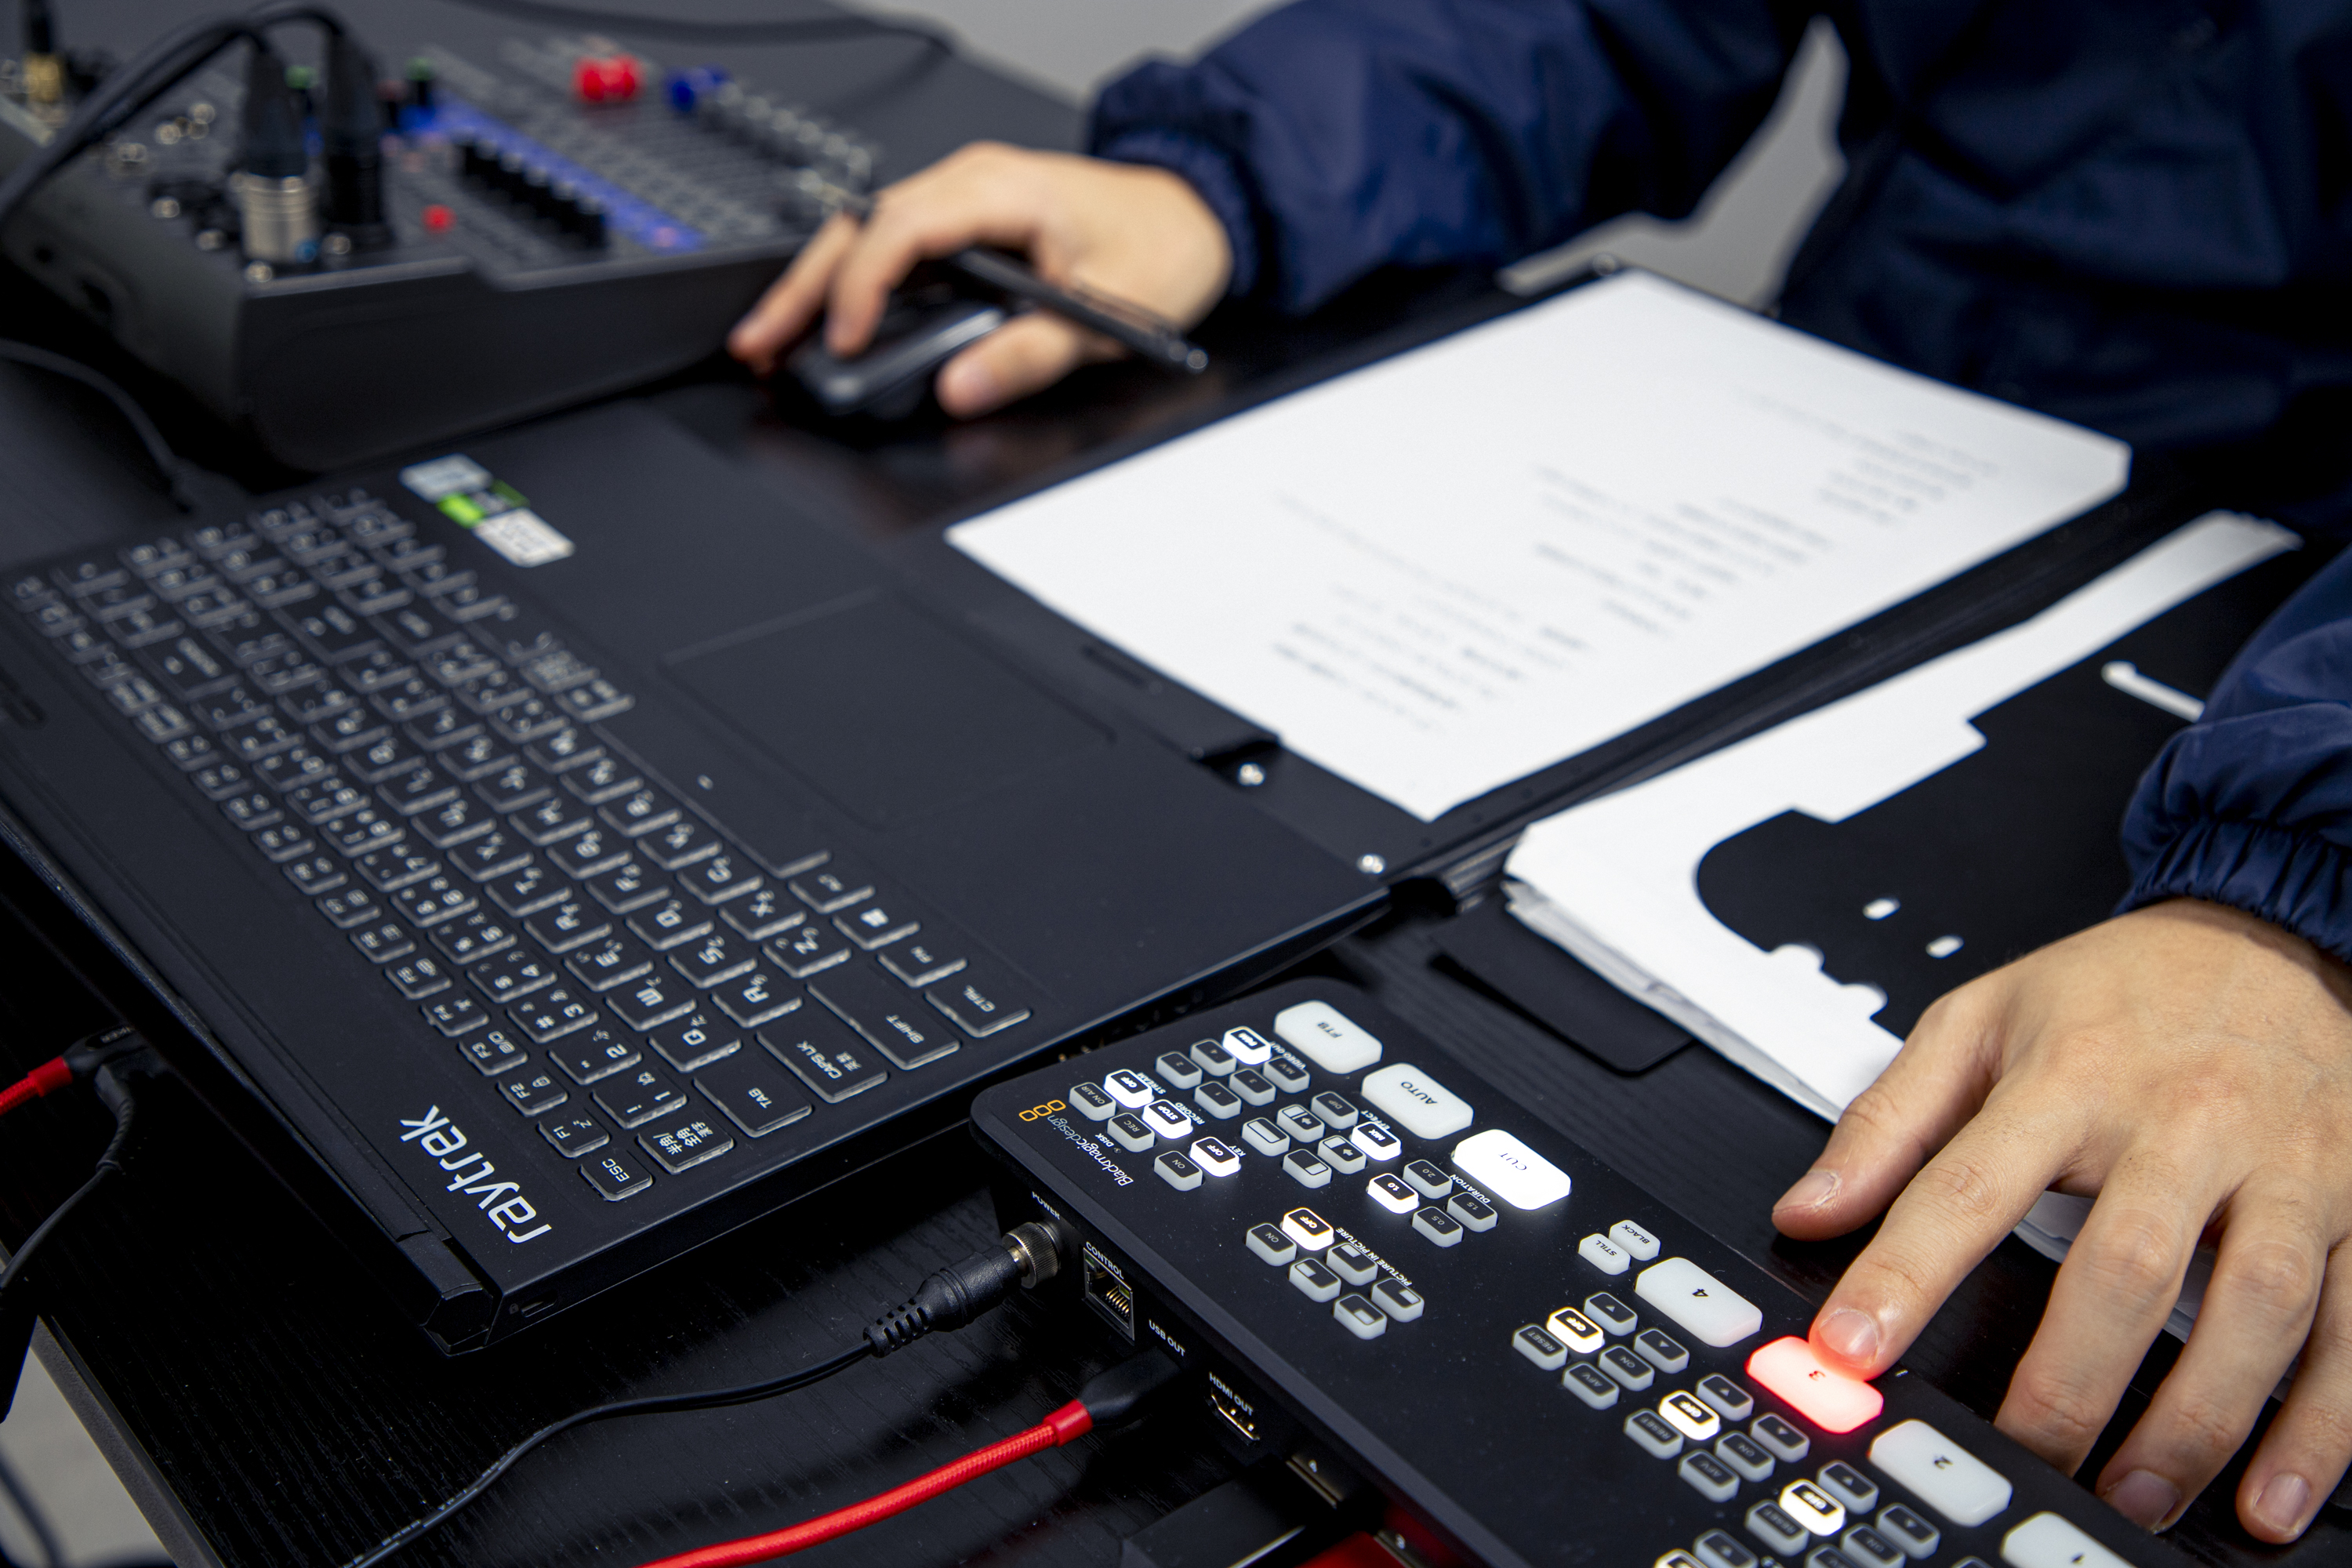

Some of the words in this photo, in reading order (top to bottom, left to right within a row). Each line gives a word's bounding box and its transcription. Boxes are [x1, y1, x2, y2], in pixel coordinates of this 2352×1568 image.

[555, 913, 579, 931] R
[655, 909, 682, 927] D
[481, 926, 503, 942] 5
[794, 935, 818, 954] Z
[594, 950, 620, 967] E
[699, 946, 724, 964] S
[521, 964, 539, 977] 4
[636, 987, 664, 1007] W
[743, 984, 769, 1004] A
[964, 985, 996, 1012] CTRL
[434, 1004, 453, 1021] F4
[563, 1004, 584, 1018] 3
[536, 1015, 554, 1029] #
[886, 1015, 924, 1044] SHIFT
[682, 1029, 706, 1046] Q
[1316, 1022, 1343, 1039] FTB
[471, 1042, 492, 1058] F3
[606, 1044, 627, 1058] 2
[811, 1053, 843, 1079] CAPS
[1278, 1062, 1297, 1075] M/V
[1283, 1053, 1307, 1069] VIDEO
[1120, 1076, 1138, 1089] OFF
[1137, 1072, 1167, 1094] STREAM
[510, 1083, 531, 1099] F2
[655, 1091, 671, 1101] 1
[748, 1087, 772, 1109] TAB
[1080, 1085, 1096, 1098] AIR
[1400, 1080, 1438, 1105] AUTO
[1097, 1094, 1106, 1105] ON
[1328, 1099, 1344, 1110] DIP
[1157, 1105, 1179, 1120] STOP
[1175, 1102, 1206, 1125] RECORD
[1360, 1109, 1391, 1131] EFFECT
[553, 1125, 571, 1139] F1
[1123, 1120, 1141, 1132] REC
[676, 1127, 702, 1147] 全角
[1094, 1132, 1115, 1149] DISK
[1367, 1128, 1386, 1142] MIX
[1047, 1113, 1134, 1186] Blackmagicdesign
[1207, 1143, 1225, 1157] OFF
[1229, 1145, 1247, 1157] KEY
[1171, 1159, 1186, 1170] ON
[1497, 1152, 1527, 1171] CUT
[400, 1105, 552, 1243] raytrek
[601, 1158, 630, 1182] ESC
[1421, 1168, 1437, 1178] 2.0
[1387, 1181, 1400, 1192] 1.0
[1450, 1174, 1491, 1203] DURATION
[1032, 1191, 1060, 1220] POWER
[1466, 1201, 1479, 1211] 1.5
[1300, 1215, 1317, 1229] OFF
[1431, 1214, 1445, 1226] 0.5
[1265, 1232, 1279, 1243] ON
[1335, 1227, 1368, 1255] PICTURE
[1621, 1224, 1650, 1245] BLACK
[1595, 1240, 1617, 1256] STILL
[1085, 1241, 1124, 1279] CONTROL
[1377, 1260, 1412, 1287] PICTURE
[1692, 1288, 1709, 1298] 4
[1565, 1316, 1587, 1332] OFF
[1149, 1319, 1166, 1341] USB
[1167, 1336, 1185, 1356] OUT
[1527, 1330, 1555, 1352] RESET
[1619, 1355, 1635, 1368] ON
[1581, 1372, 1603, 1388] AFV
[1809, 1370, 1827, 1381] 3
[1209, 1371, 1232, 1399] HDMI
[1233, 1396, 1254, 1416] OUT
[1679, 1400, 1703, 1417] OFF
[1737, 1443, 1755, 1457] ON
[1698, 1460, 1722, 1479] AFV
[1933, 1455, 1954, 1470] 2
